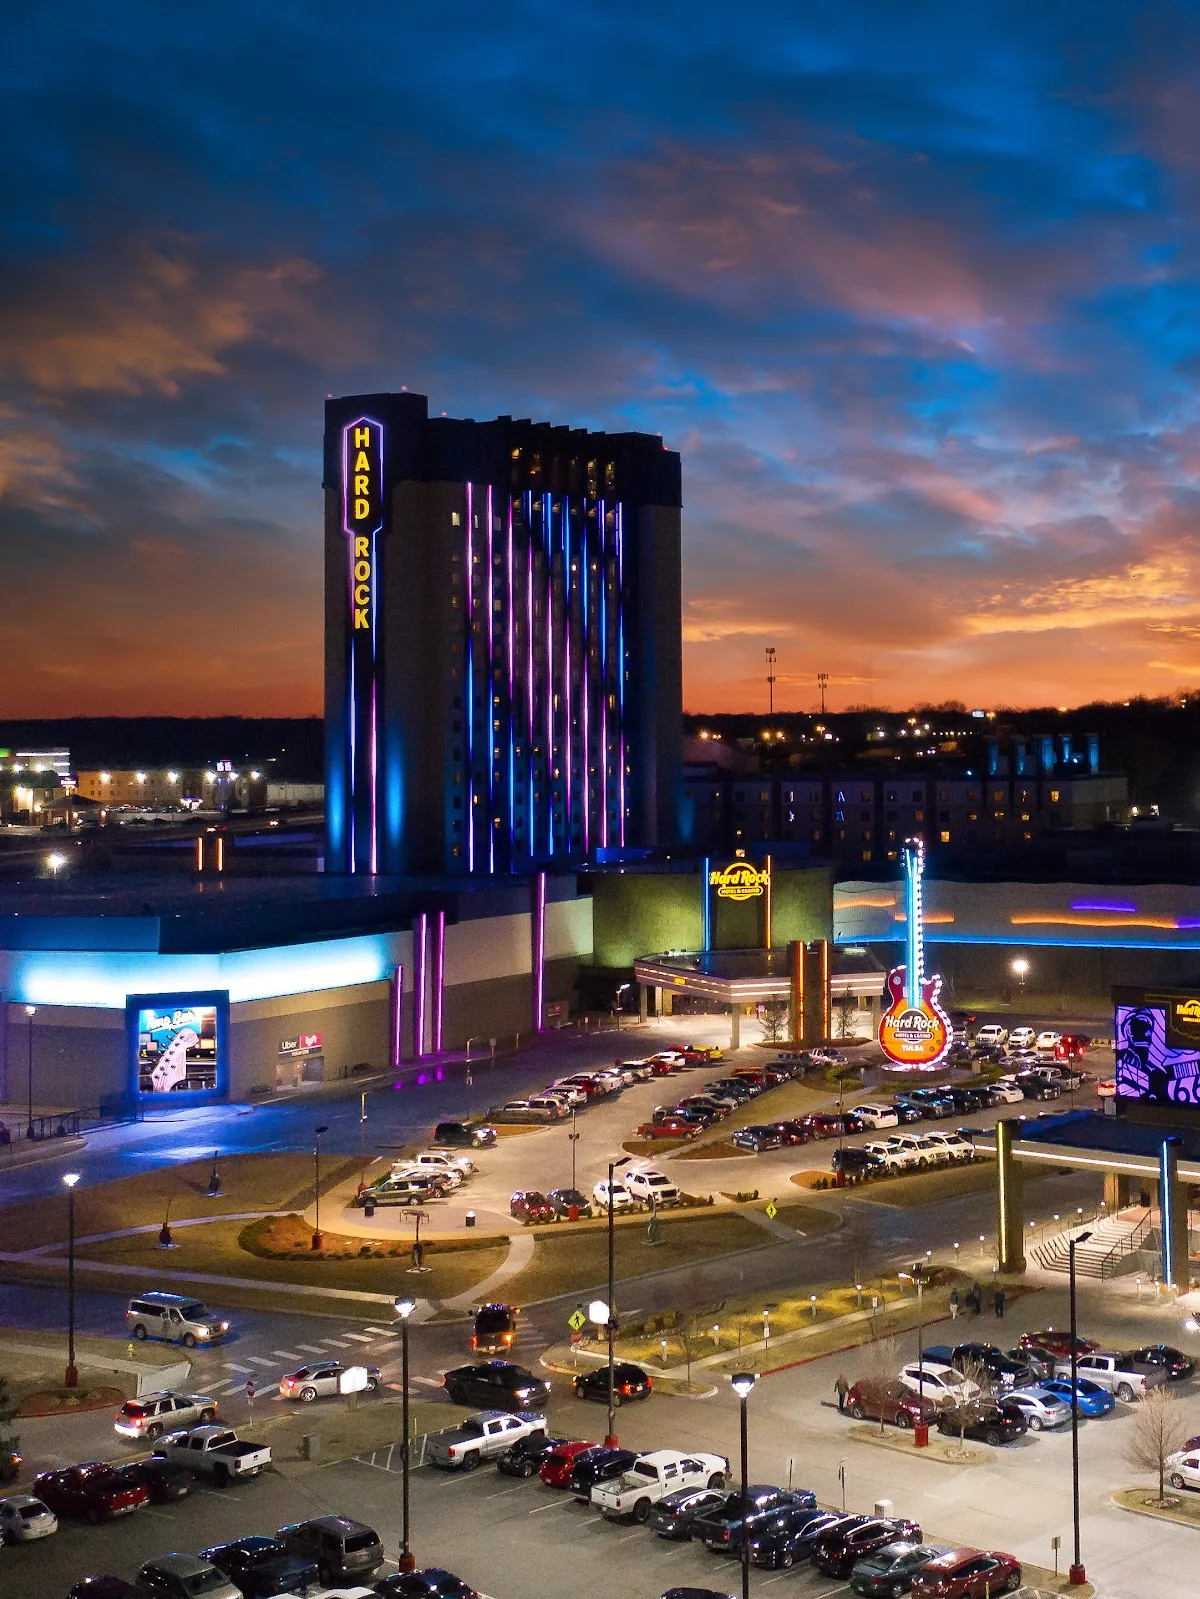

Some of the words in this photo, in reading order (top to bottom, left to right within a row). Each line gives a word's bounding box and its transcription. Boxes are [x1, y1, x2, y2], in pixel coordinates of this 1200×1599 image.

[354, 427, 370, 520] HARD
[354, 536, 370, 630] ROCK
[710, 870, 741, 885] Hard
[741, 870, 770, 886] Rock
[1176, 1004, 1195, 1015] Hard
[885, 1015, 913, 1028] Hard
[912, 1015, 940, 1031] Rock
[281, 1041, 298, 1050] Uber
[901, 1044, 924, 1052] TULSA
